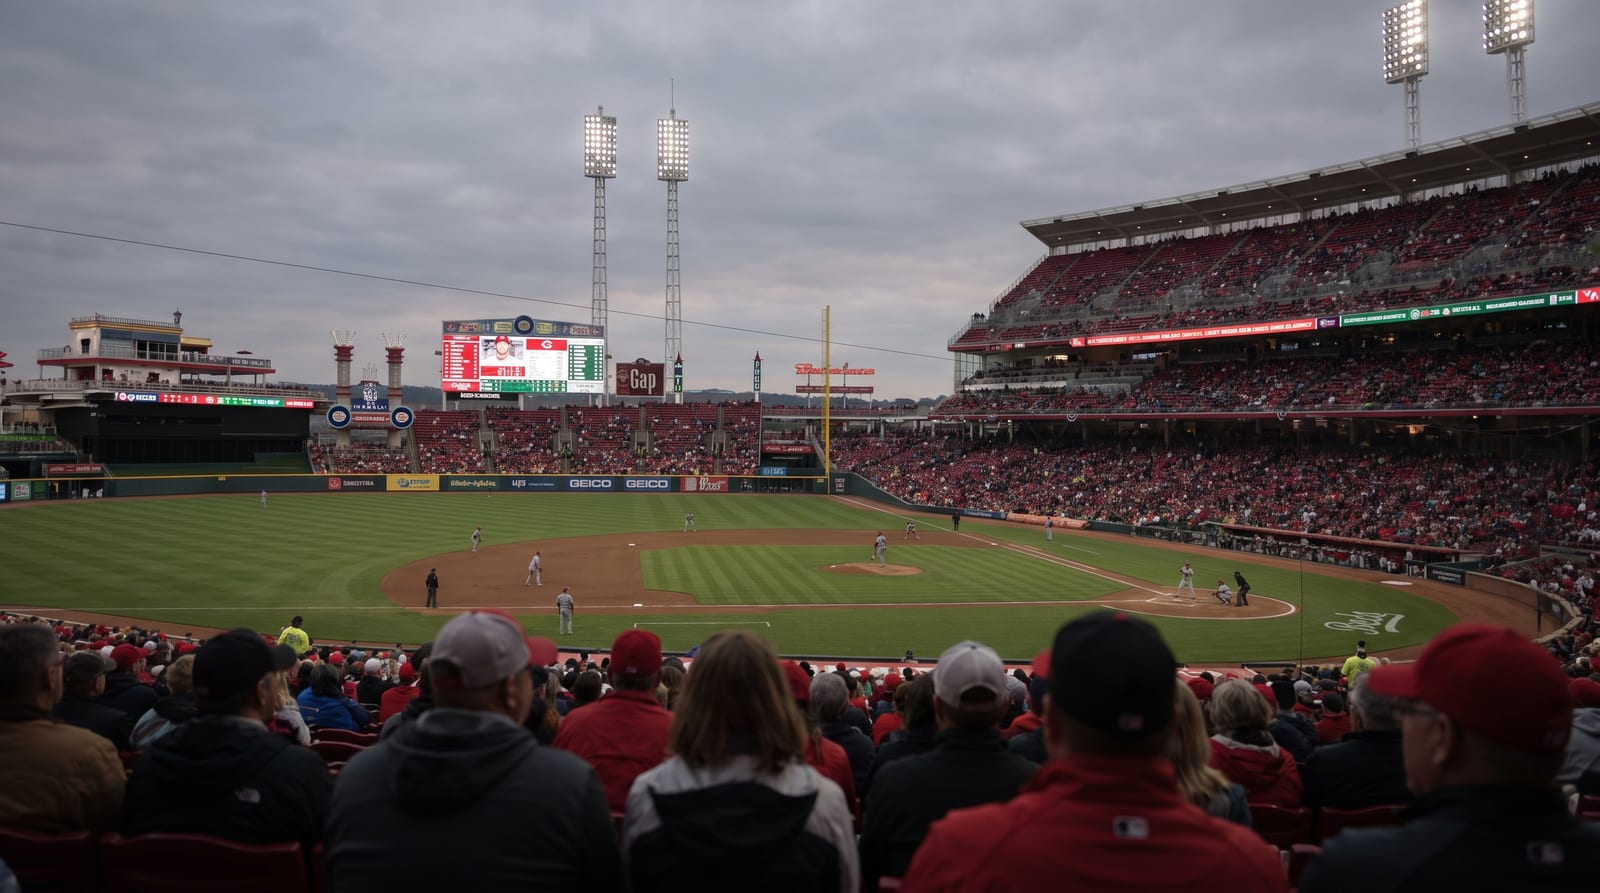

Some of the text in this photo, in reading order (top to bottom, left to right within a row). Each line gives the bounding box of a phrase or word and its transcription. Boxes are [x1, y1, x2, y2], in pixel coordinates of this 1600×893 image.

[630, 368, 656, 395] Gap
[569, 479, 612, 488] GEICO
[626, 479, 669, 488] GEICO
